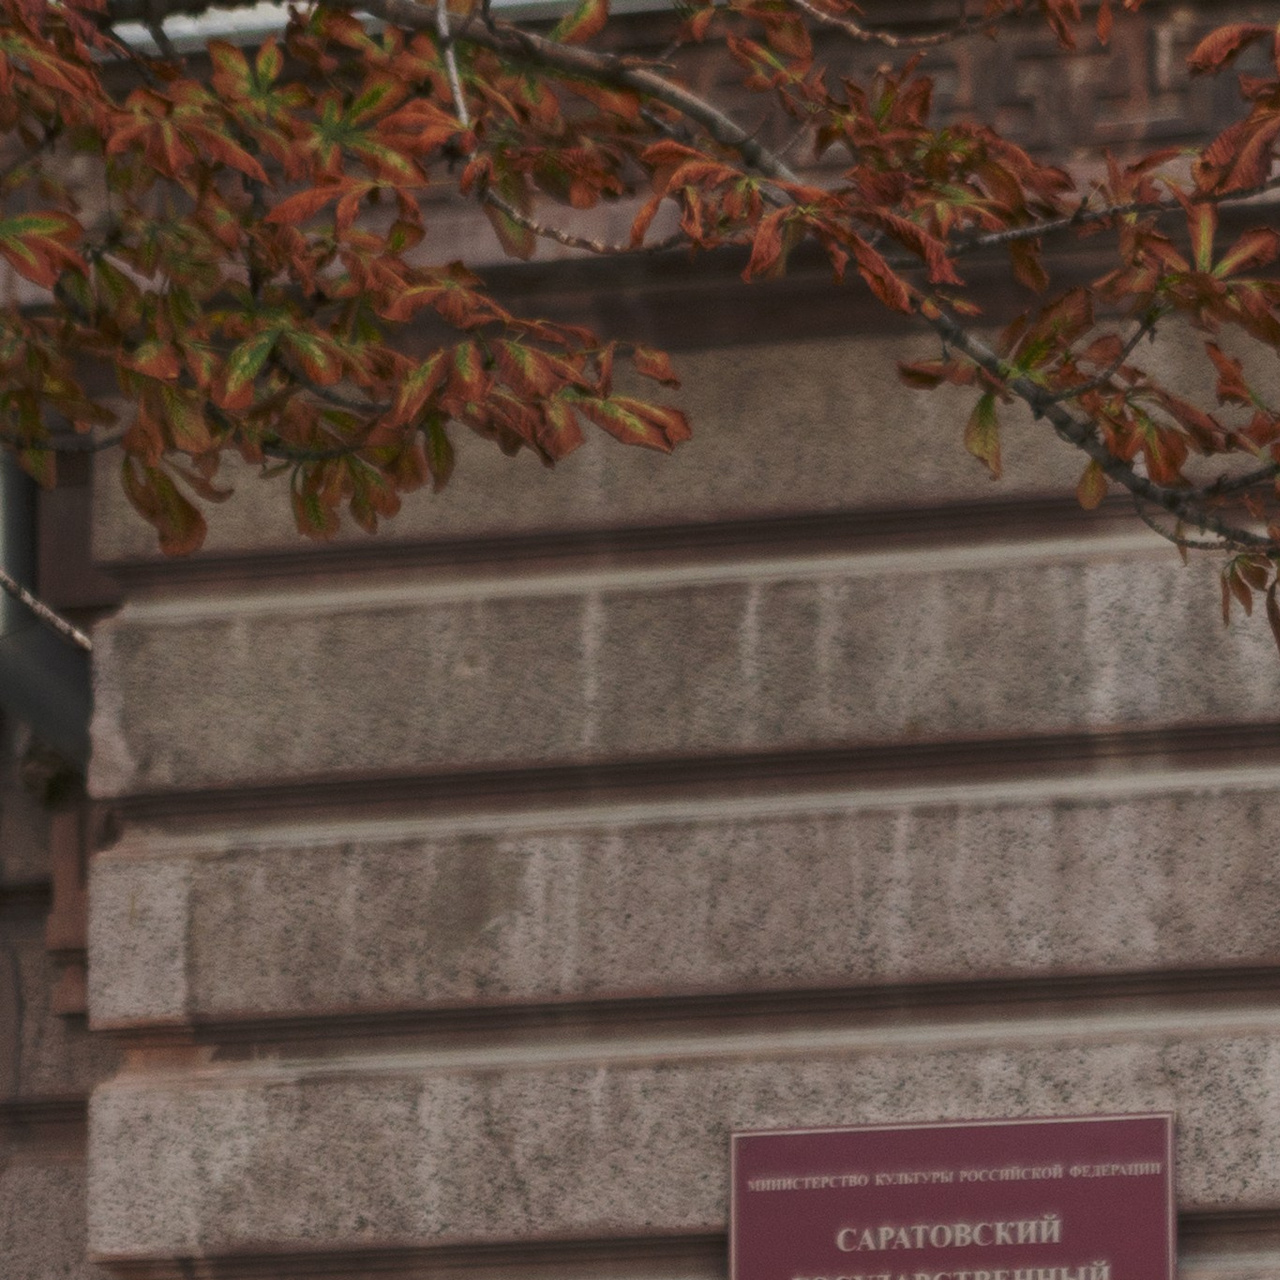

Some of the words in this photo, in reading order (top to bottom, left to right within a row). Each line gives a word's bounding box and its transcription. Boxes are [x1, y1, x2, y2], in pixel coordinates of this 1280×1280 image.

[748, 1175, 869, 1192] МИНИСТЕРСТВО
[875, 1170, 953, 1186] КУЛЬТУРЫ
[960, 1164, 1063, 1183] РОССИЙСКОЙ
[1069, 1162, 1161, 1179] ФЕДЕРАЦИИ
[836, 1214, 1062, 1252] САРАТОВСКИЙ
